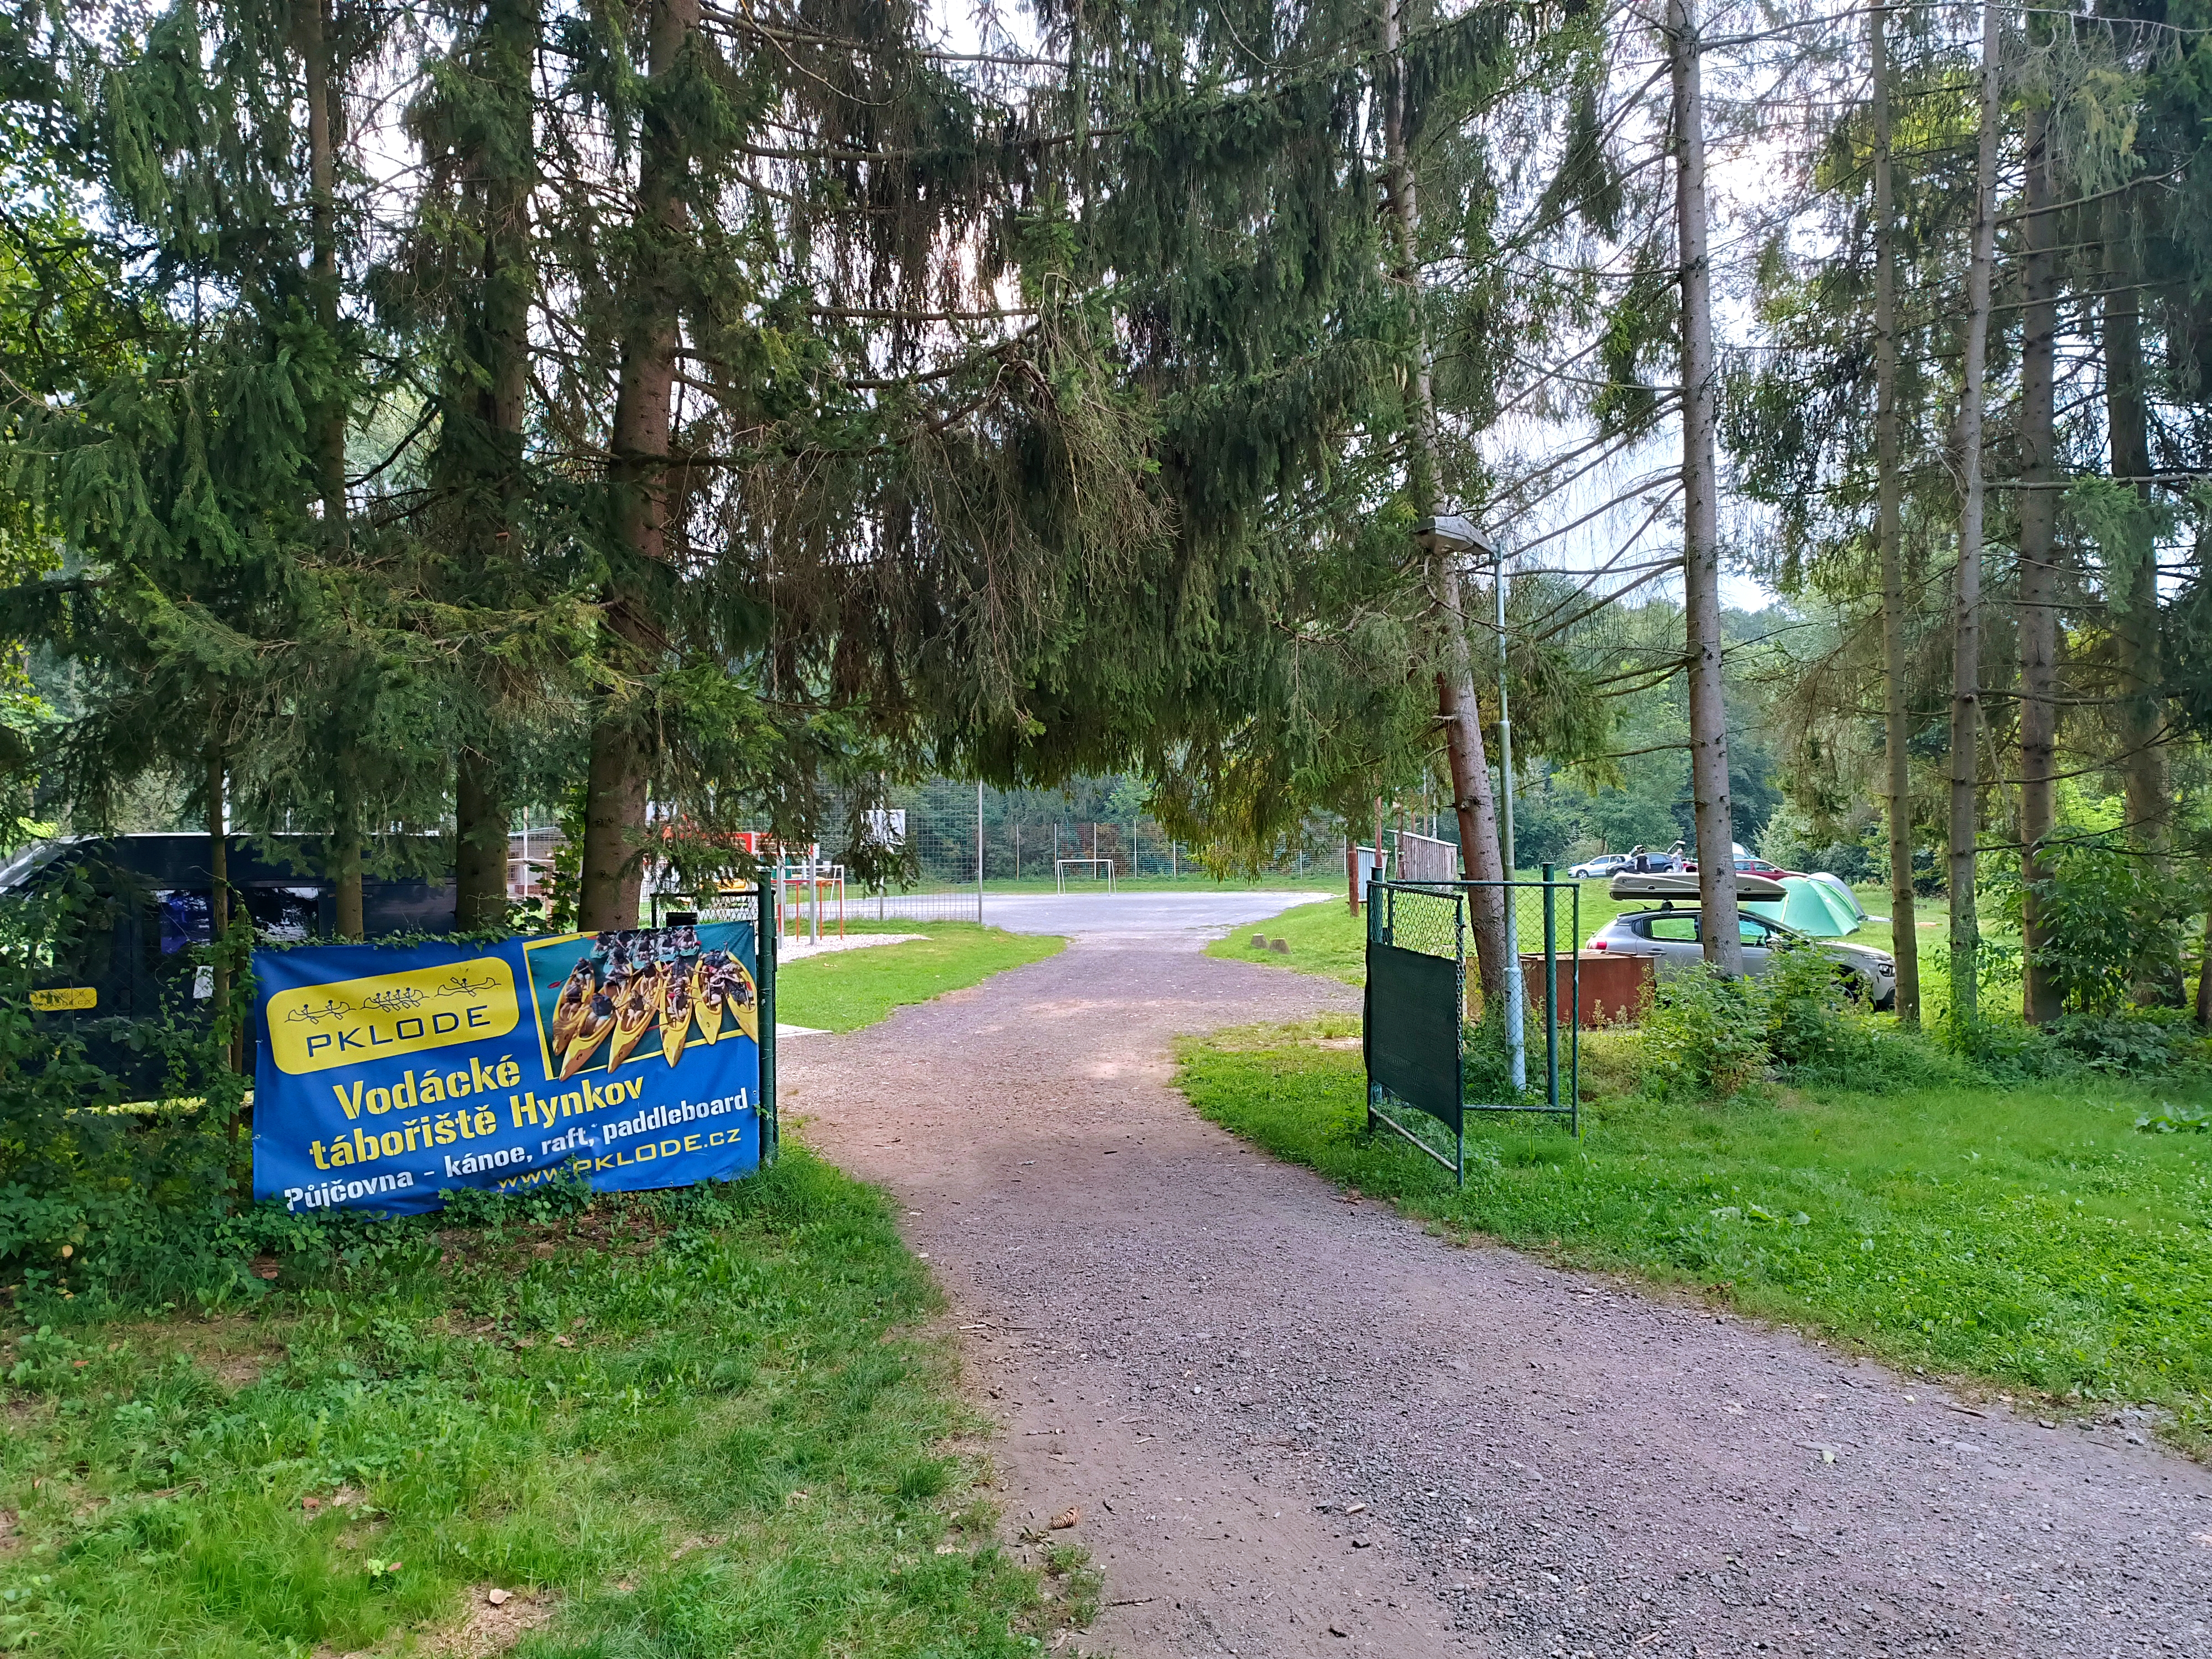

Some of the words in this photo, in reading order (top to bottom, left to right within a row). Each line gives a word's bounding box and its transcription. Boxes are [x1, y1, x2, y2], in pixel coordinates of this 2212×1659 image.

[306, 1005, 491, 1057] PKLODE
[309, 1104, 497, 1170] tábořiště
[510, 1076, 644, 1129] Hynkov
[332, 1053, 520, 1120] Vodácké
[284, 1170, 414, 1211] Půjčovna
[444, 1148, 533, 1178] kánoe,
[541, 1127, 594, 1156] raft,
[603, 1087, 748, 1145] paddleboard
